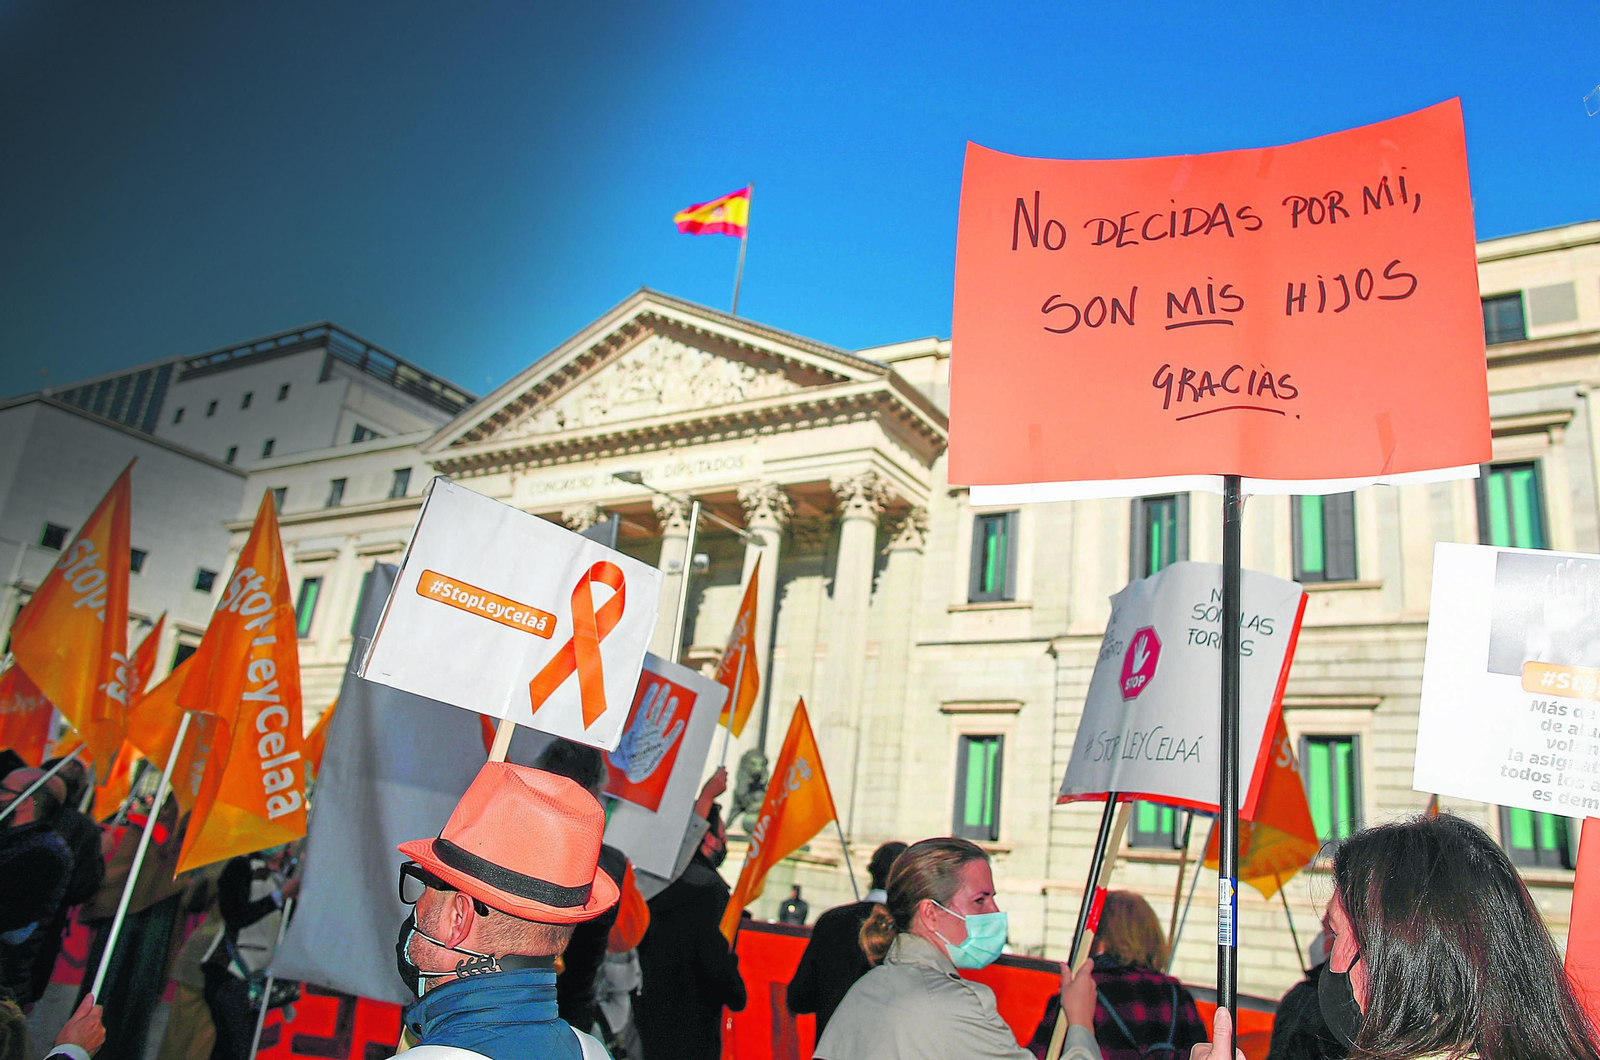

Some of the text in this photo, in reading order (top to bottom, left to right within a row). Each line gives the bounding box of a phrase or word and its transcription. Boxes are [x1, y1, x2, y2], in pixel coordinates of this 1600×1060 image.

[1083, 199, 1263, 247] DECIDAS
[1282, 195, 1350, 228] POR
[1041, 260, 1417, 333] SON MIS HIJOS
[429, 579, 548, 631] #StopLeyCelaá
[1239, 612, 1276, 636] LAS
[1124, 675, 1146, 690] STOP
[1530, 699, 1568, 716] Más
[1541, 718, 1563, 733] de
[1507, 748, 1524, 763] la
[1500, 765, 1552, 784] todos
[1532, 789, 1553, 802] es
